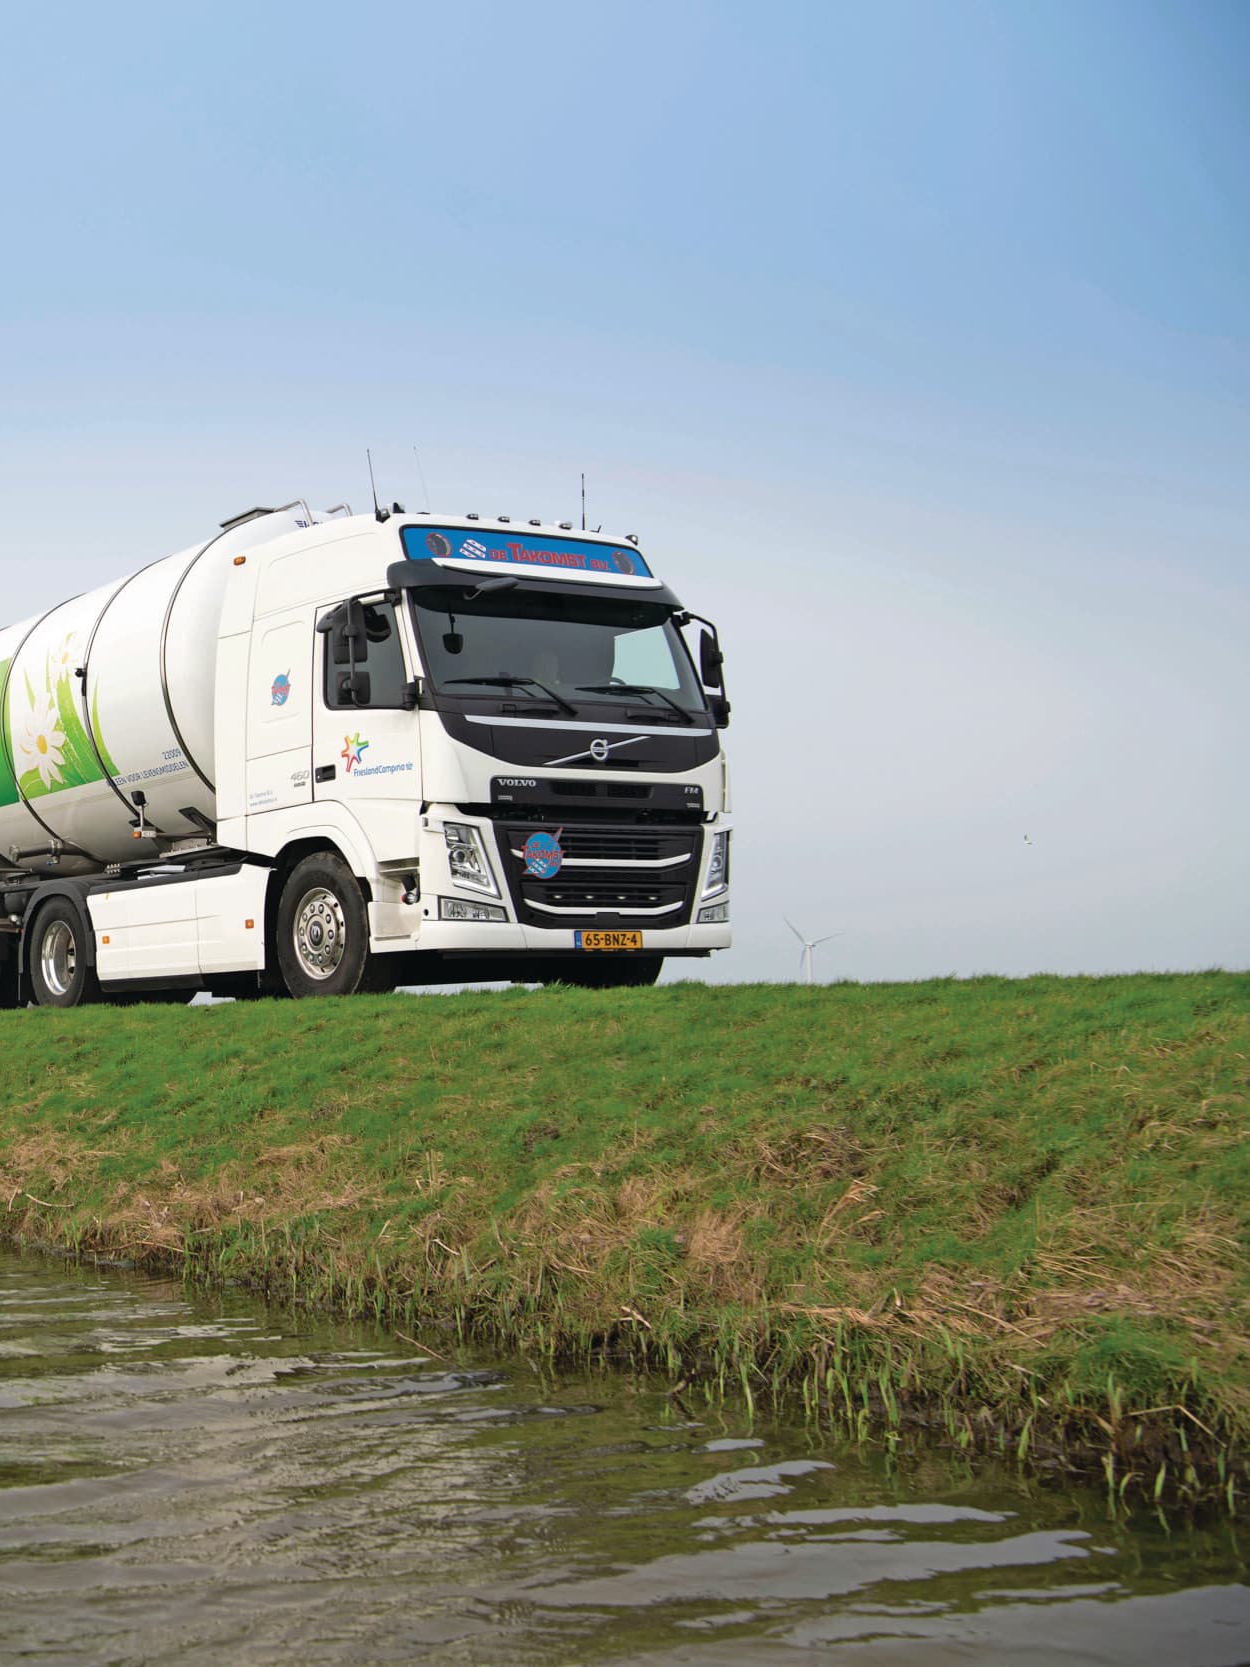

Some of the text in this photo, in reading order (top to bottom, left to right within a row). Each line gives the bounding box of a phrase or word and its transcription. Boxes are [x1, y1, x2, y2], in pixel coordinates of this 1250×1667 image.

[490, 549, 507, 560] DE
[506, 542, 585, 568] TAKOMST
[354, 763, 405, 776] FrieslandCampina
[126, 772, 141, 782] VOOR
[290, 770, 310, 781] 460
[497, 778, 536, 787] VOLVO
[684, 786, 699, 794] FM
[585, 933, 638, 946] 65-BNZ-4
